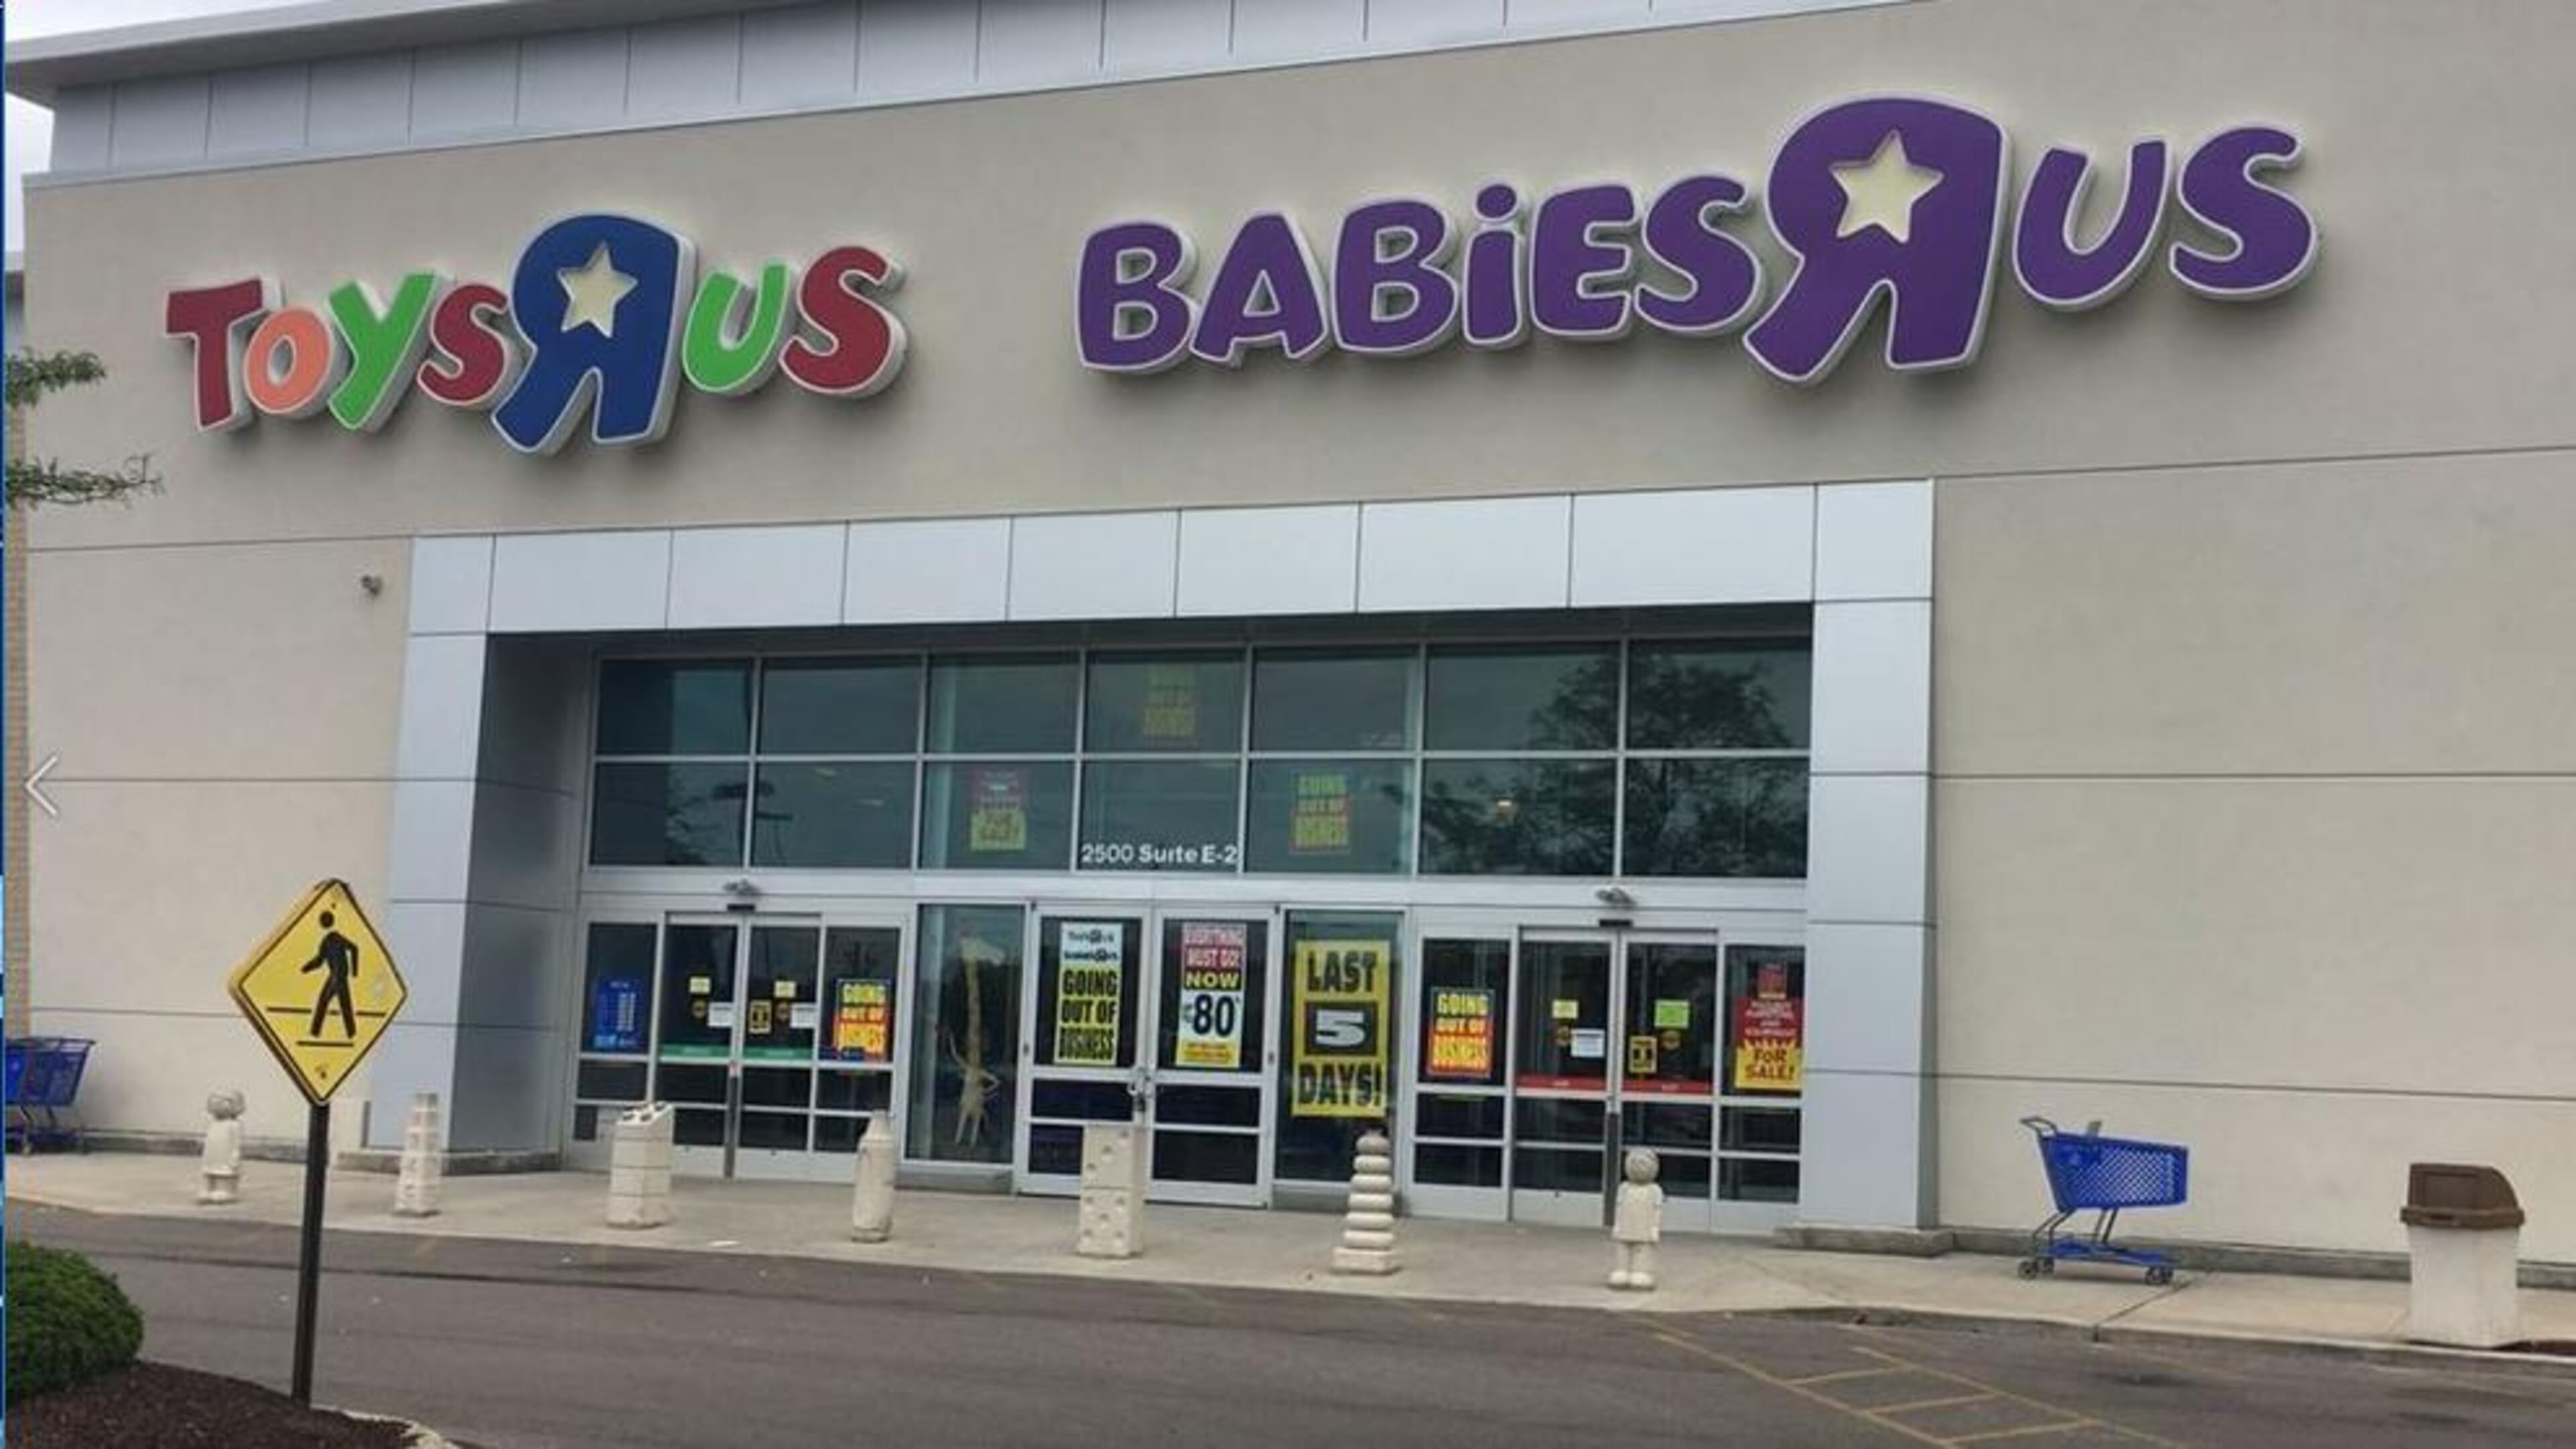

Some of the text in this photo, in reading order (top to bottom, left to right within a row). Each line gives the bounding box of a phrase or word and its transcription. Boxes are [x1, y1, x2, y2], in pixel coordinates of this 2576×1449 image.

[1081, 843, 1237, 864] 2500 Suite E-2
[1063, 970, 1118, 997] GOING
[1185, 971, 1239, 989] NOW
[1307, 950, 1376, 993] LAST
[1061, 1000, 1117, 1024] OUT OF
[1437, 993, 1489, 1016] GOING
[1315, 1009, 1366, 1047] 5
[1436, 1017, 1487, 1034] OUT OF
[1058, 1026, 1114, 1060] BUSINESS
[1754, 1049, 1788, 1063] FOR
[1298, 1062, 1382, 1106] DAYS!
